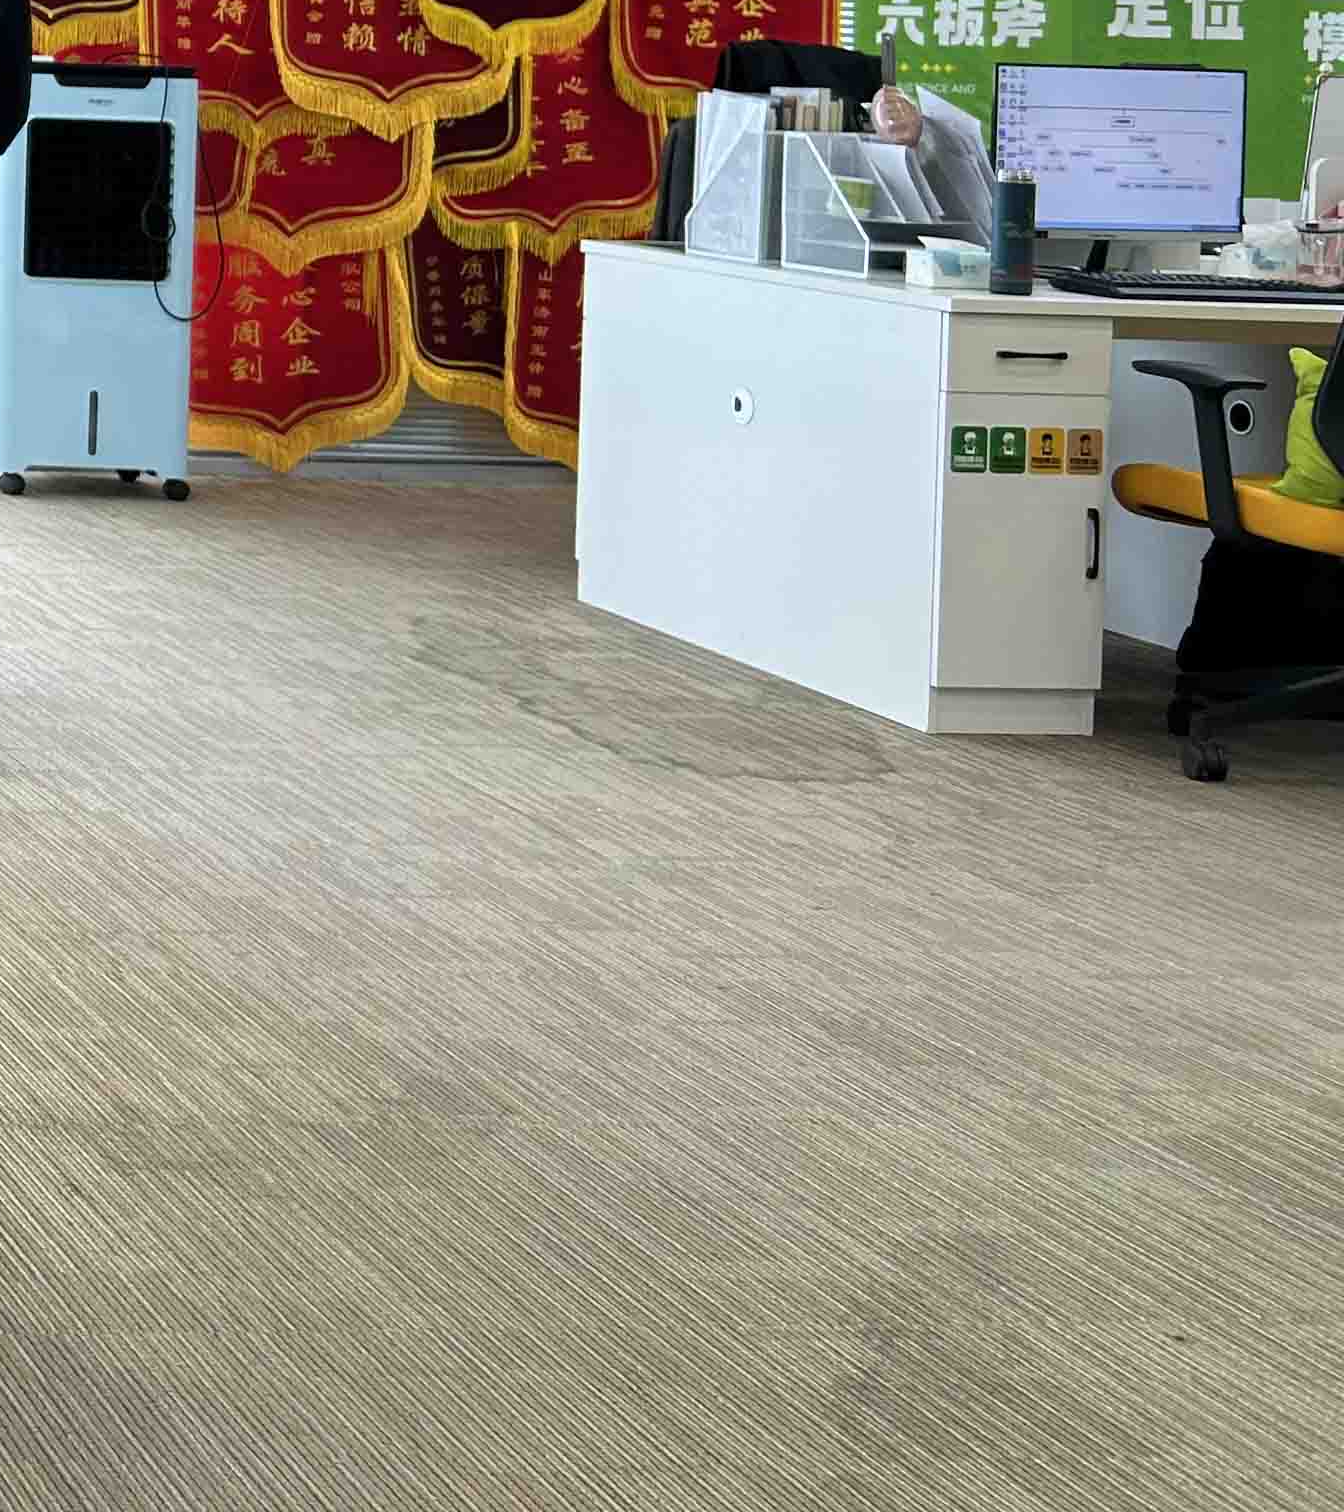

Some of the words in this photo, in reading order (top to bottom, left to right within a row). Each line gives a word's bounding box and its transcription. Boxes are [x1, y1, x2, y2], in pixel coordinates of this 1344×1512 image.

[557, 54, 595, 164] 心备至
[279, 265, 322, 377] 心企业
